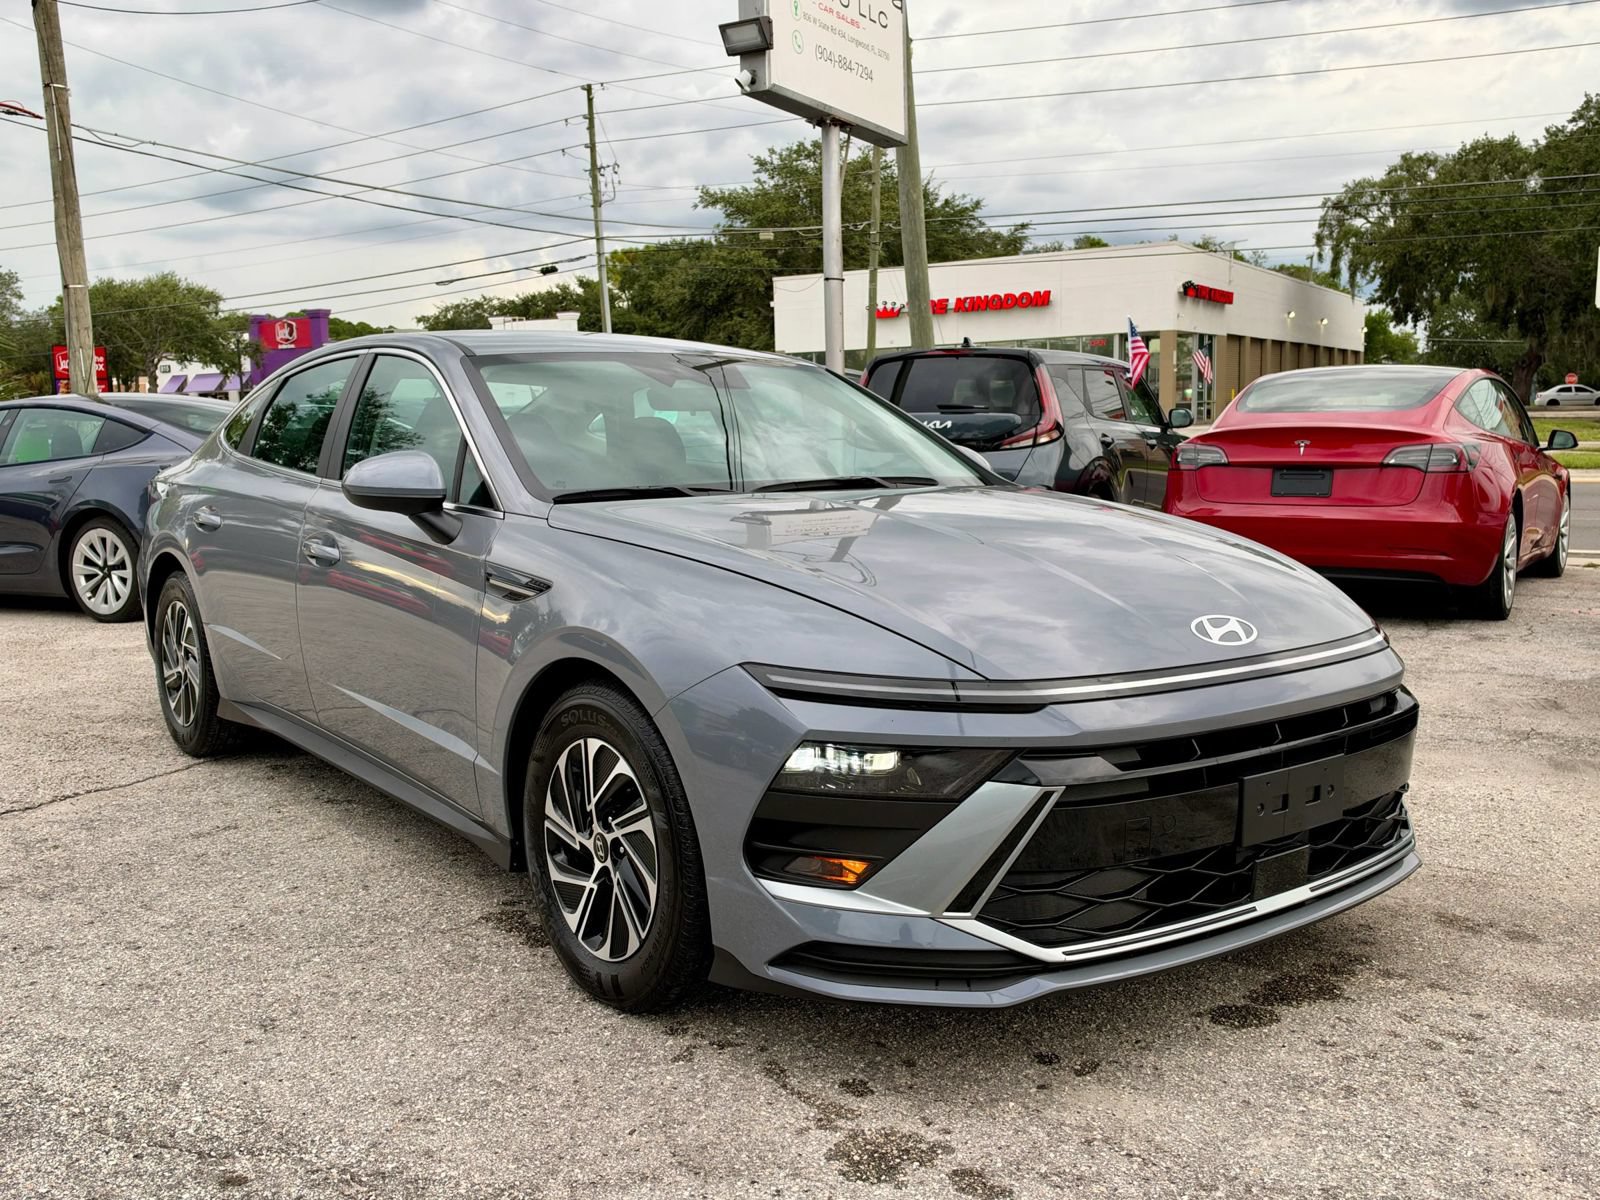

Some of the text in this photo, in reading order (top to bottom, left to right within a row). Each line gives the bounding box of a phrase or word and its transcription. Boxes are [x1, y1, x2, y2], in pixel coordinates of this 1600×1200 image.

[818, 2, 834, 15] CAR
[836, 10, 861, 29] SALES
[814, 43, 874, 82] (904)-884-7294
[953, 289, 1052, 313] KINGDOM
[561, 709, 607, 728] SOLUS
